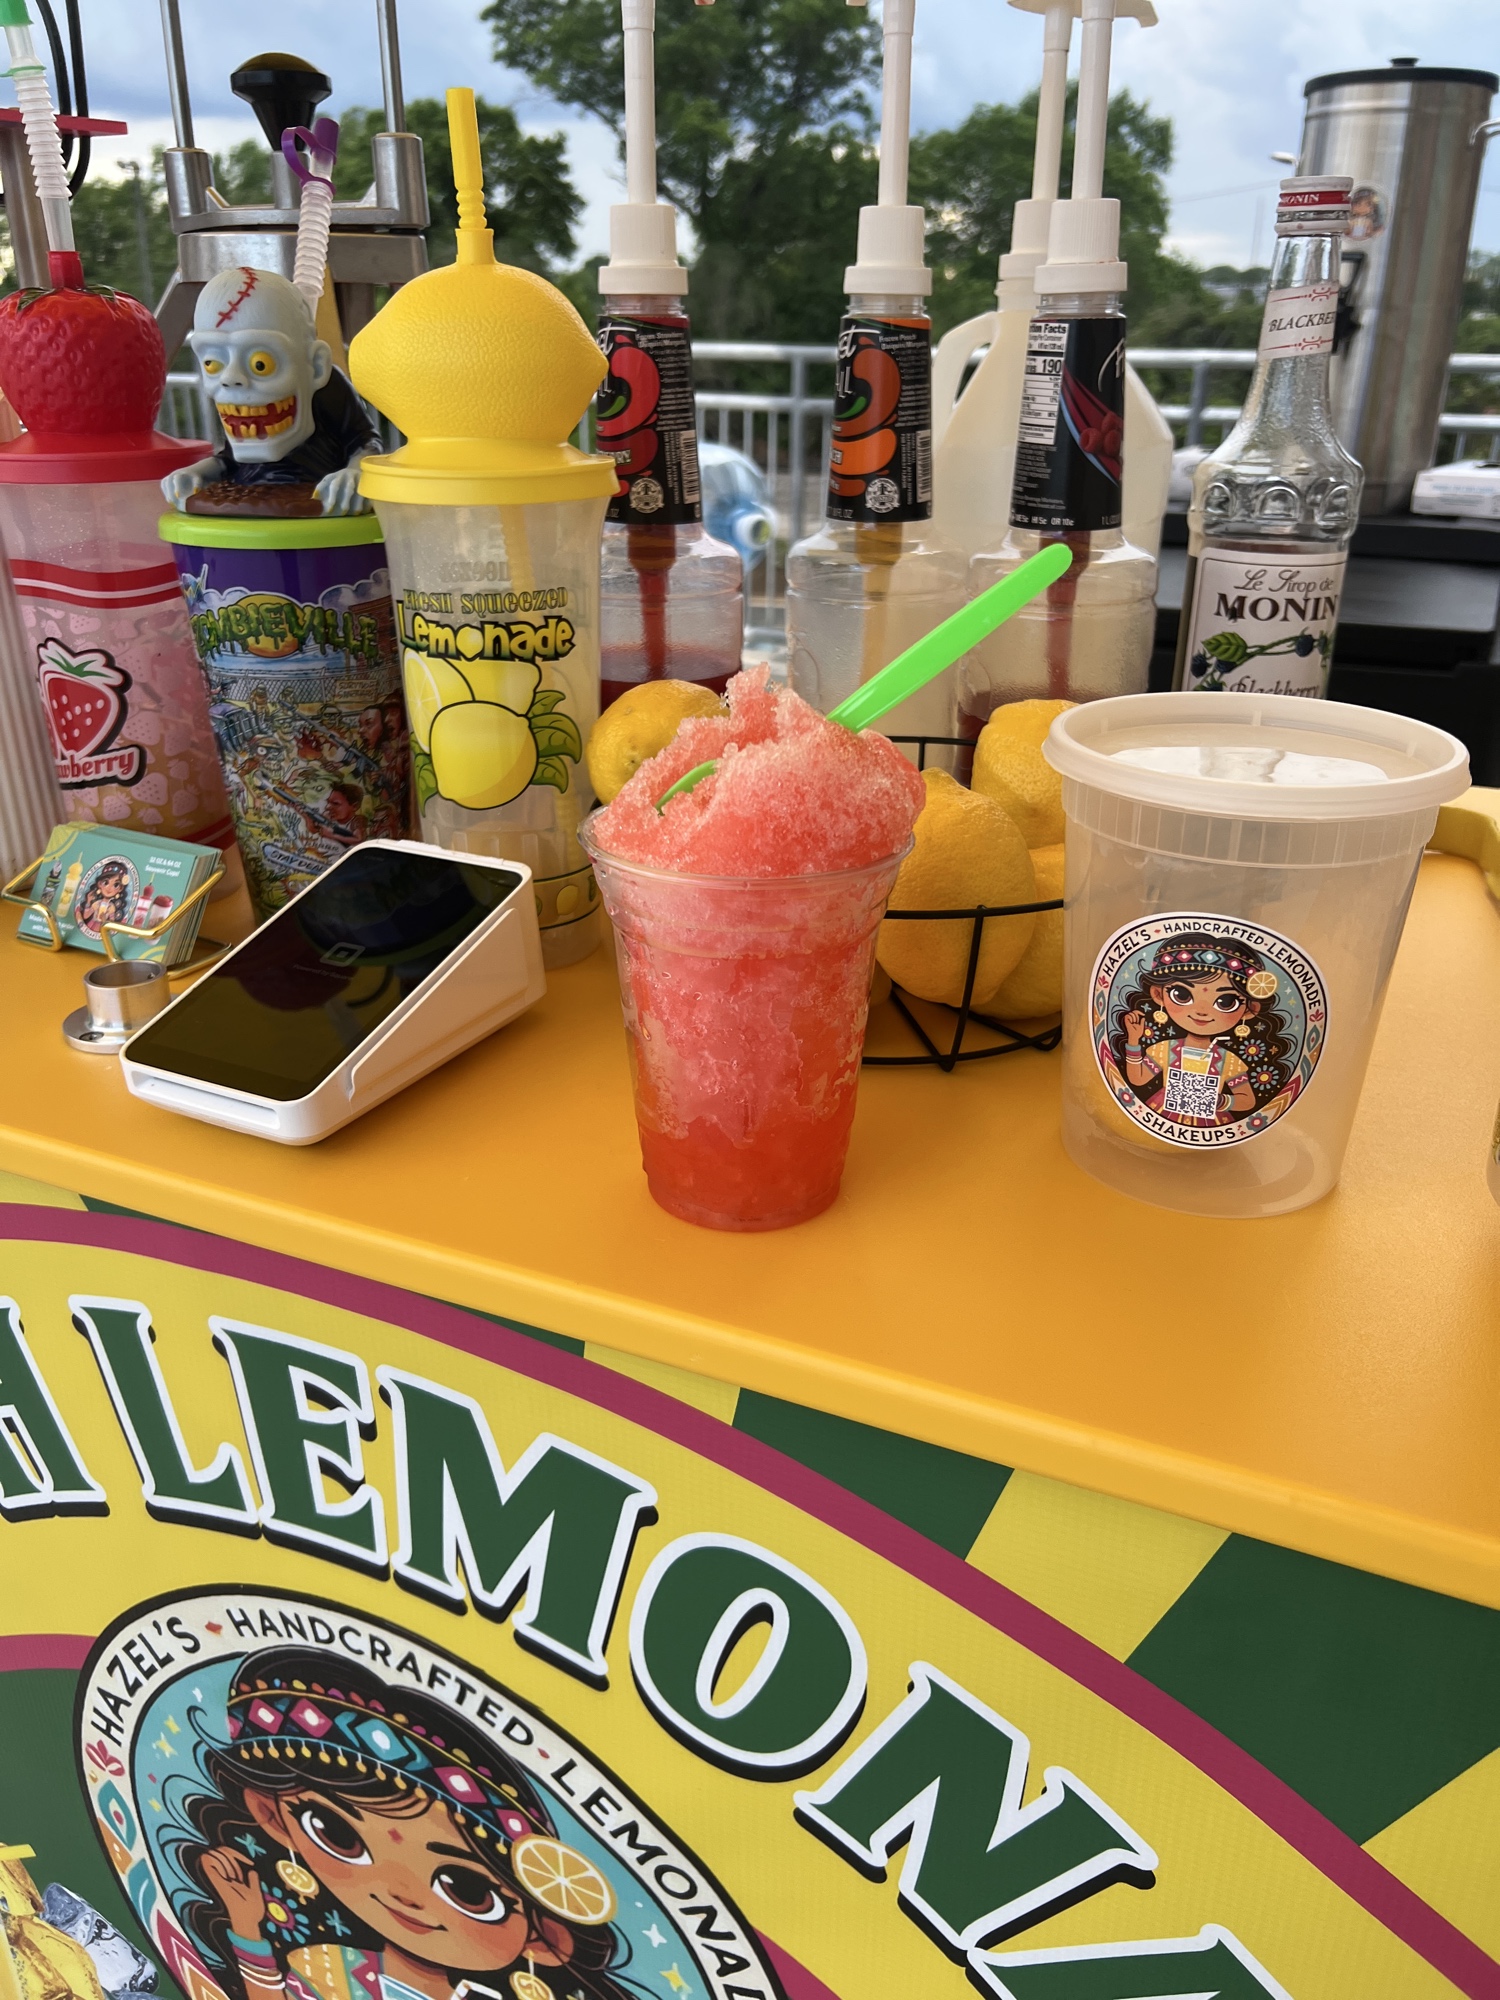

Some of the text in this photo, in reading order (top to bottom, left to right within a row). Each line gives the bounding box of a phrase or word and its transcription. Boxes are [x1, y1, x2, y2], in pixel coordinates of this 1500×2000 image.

[1043, 323, 1067, 334] Facts
[1042, 358, 1062, 374] 190
[1233, 569, 1334, 598] Le Sirop de
[1213, 592, 1339, 623] MONIN
[298, 858, 326, 874] DEA
[1102, 921, 1322, 1009] HAZEL'S HANDCRAFTED LEMONADE
[1141, 1111, 1237, 1142] SHAKEUPS
[89, 1616, 200, 1747] HAZEL'S
[225, 1606, 535, 1748] HANDCRAFTED
